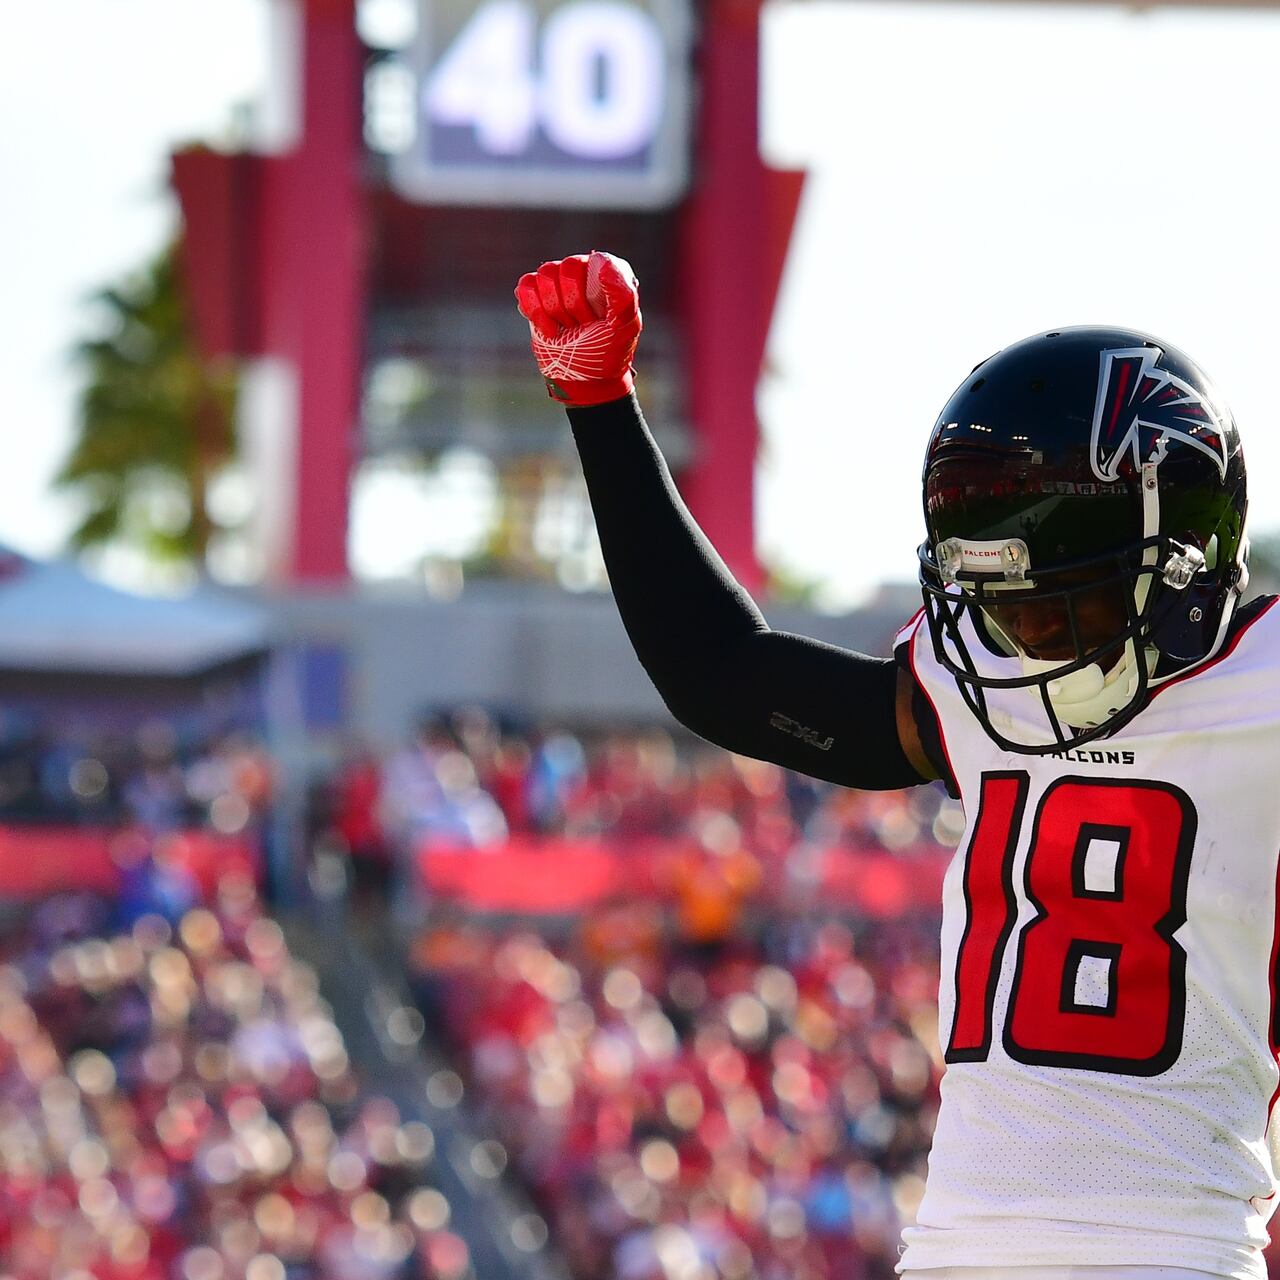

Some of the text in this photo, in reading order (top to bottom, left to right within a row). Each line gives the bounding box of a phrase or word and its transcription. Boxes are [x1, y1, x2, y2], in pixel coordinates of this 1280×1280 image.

[423, 0, 666, 159] 40
[1040, 749, 1135, 765] ALCONS
[944, 769, 1199, 1078] 18
